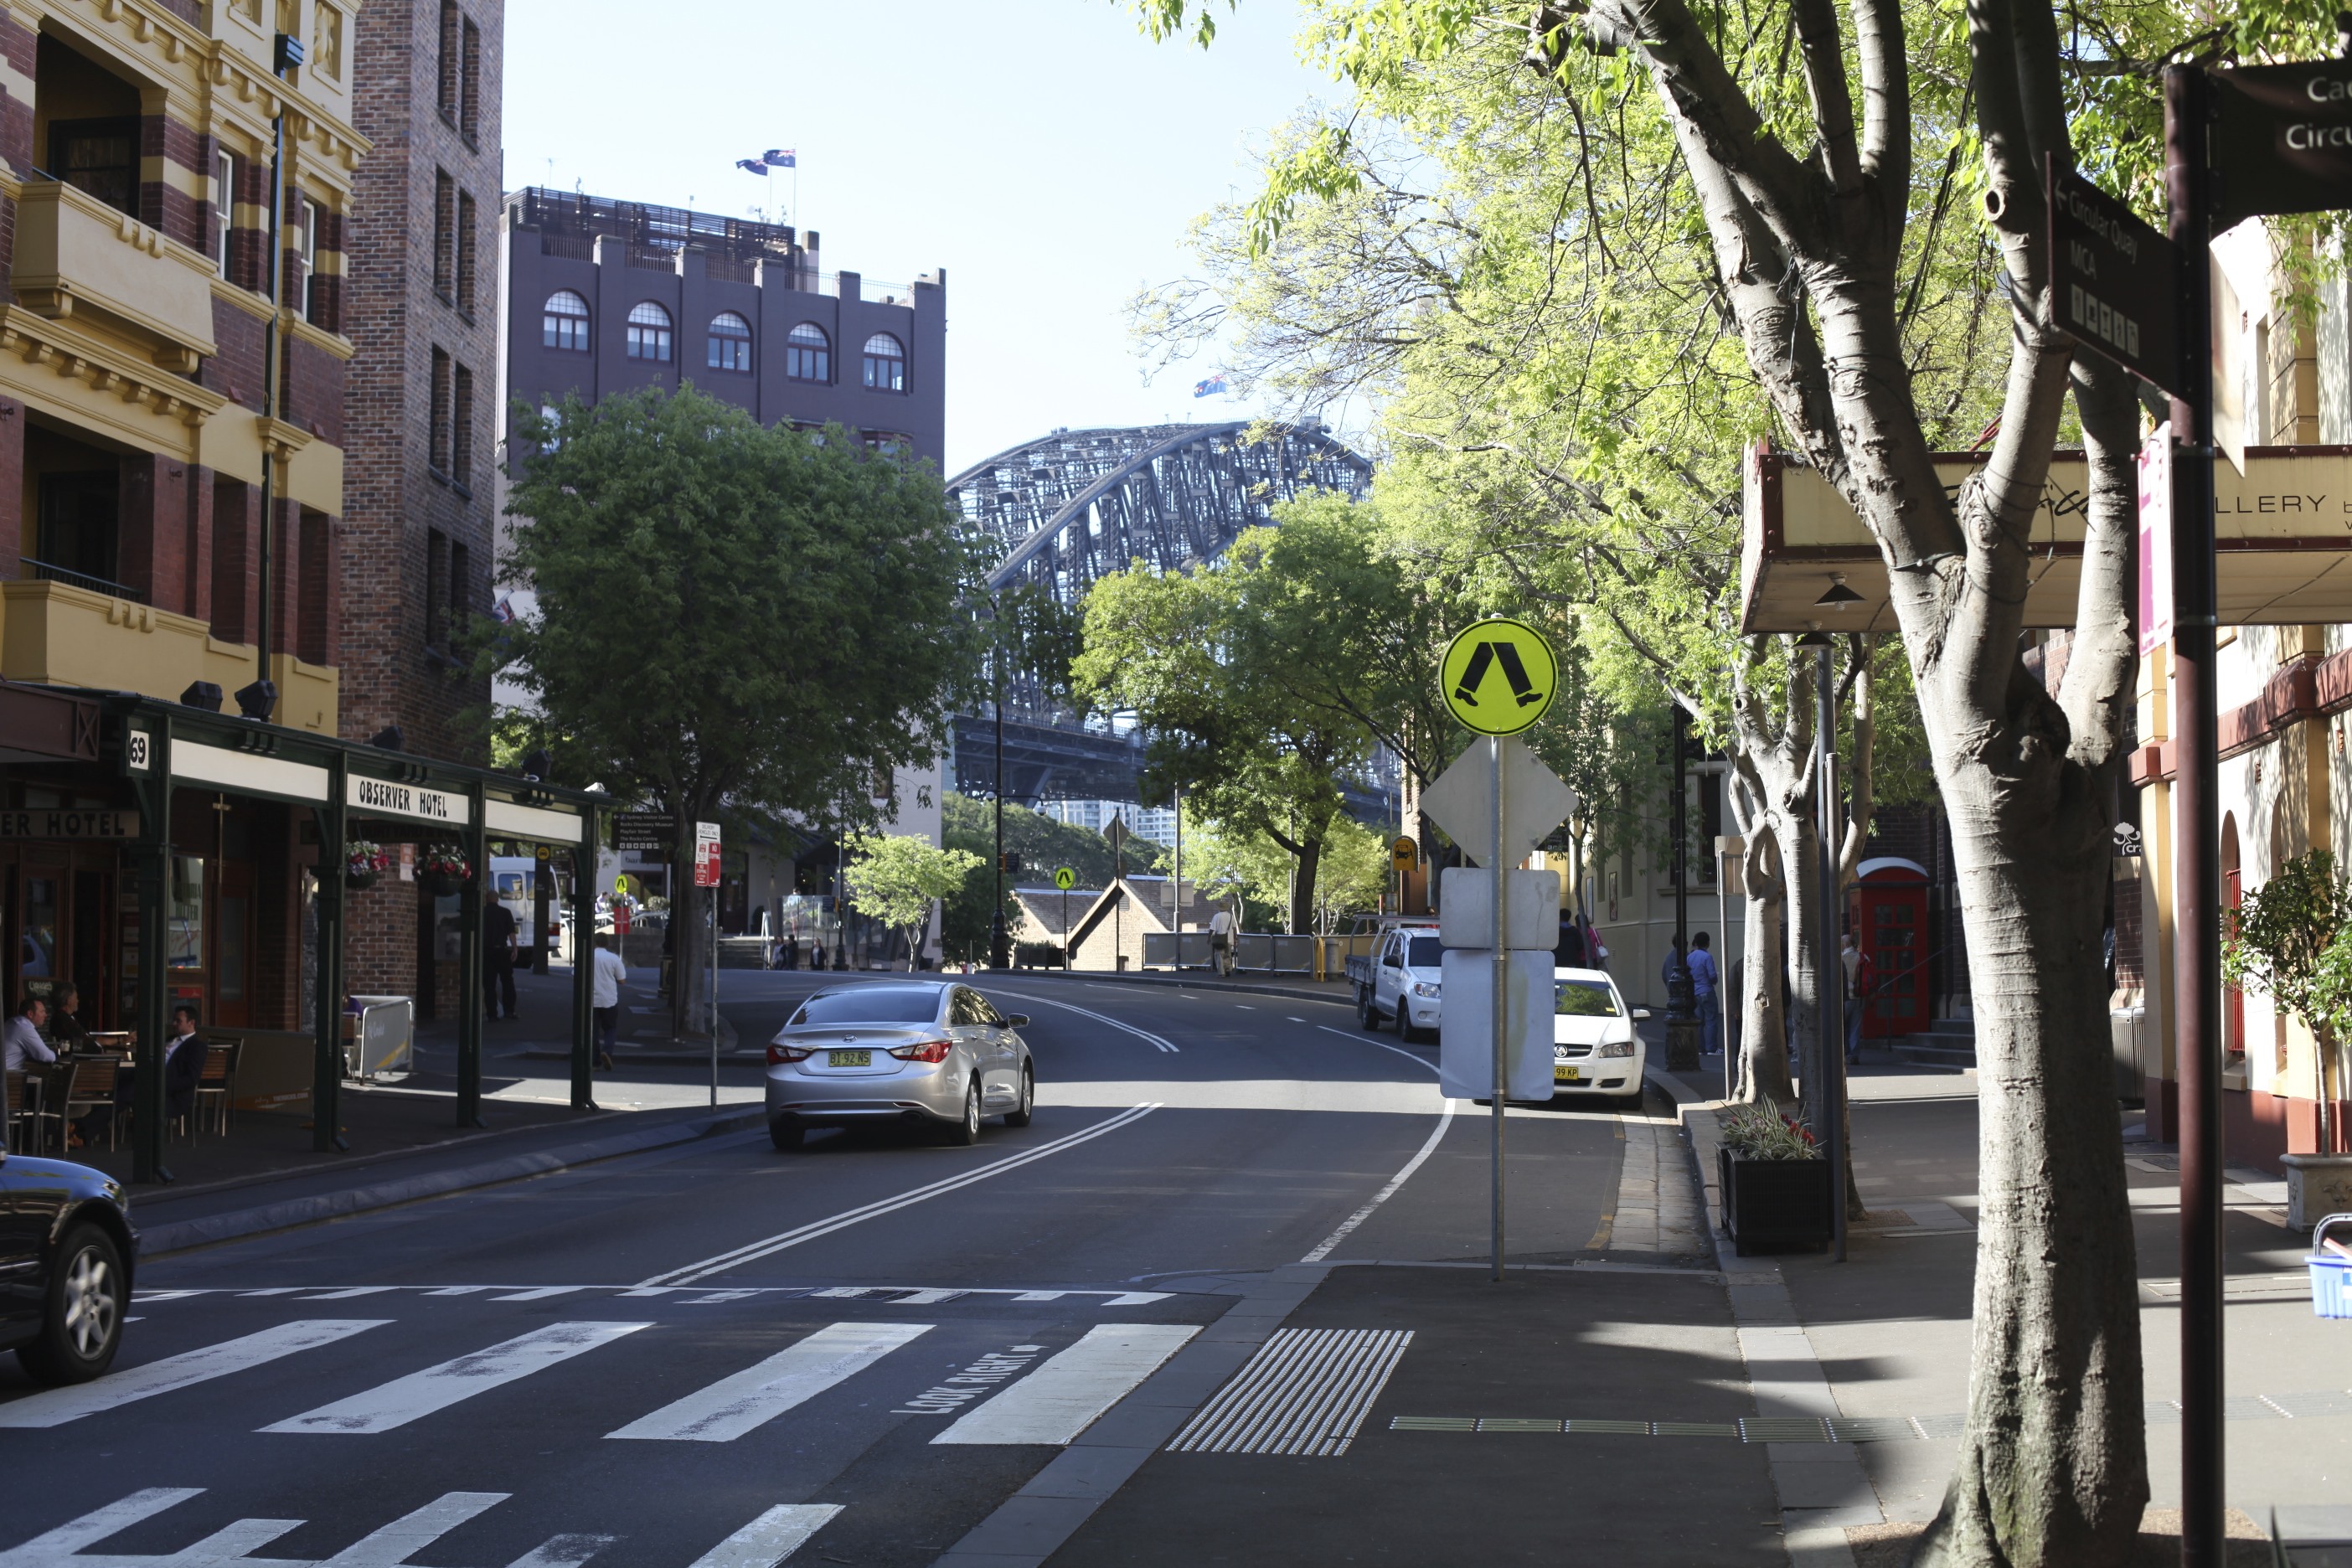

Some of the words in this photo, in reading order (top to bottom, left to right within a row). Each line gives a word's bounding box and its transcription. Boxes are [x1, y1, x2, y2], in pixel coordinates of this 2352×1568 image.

[2069, 189, 2109, 240] Circular
[2110, 219, 2138, 265] Quay
[2070, 238, 2097, 281] MCA
[2215, 495, 2326, 513] LLERY
[129, 737, 146, 764] 69
[359, 780, 410, 811] OBSERVER
[420, 792, 446, 818] HOTEL
[47, 813, 124, 835] HOTEL
[2126, 844, 2141, 853] cr
[890, 1386, 990, 1413] LOOK
[944, 1353, 1038, 1383] RIGHT
